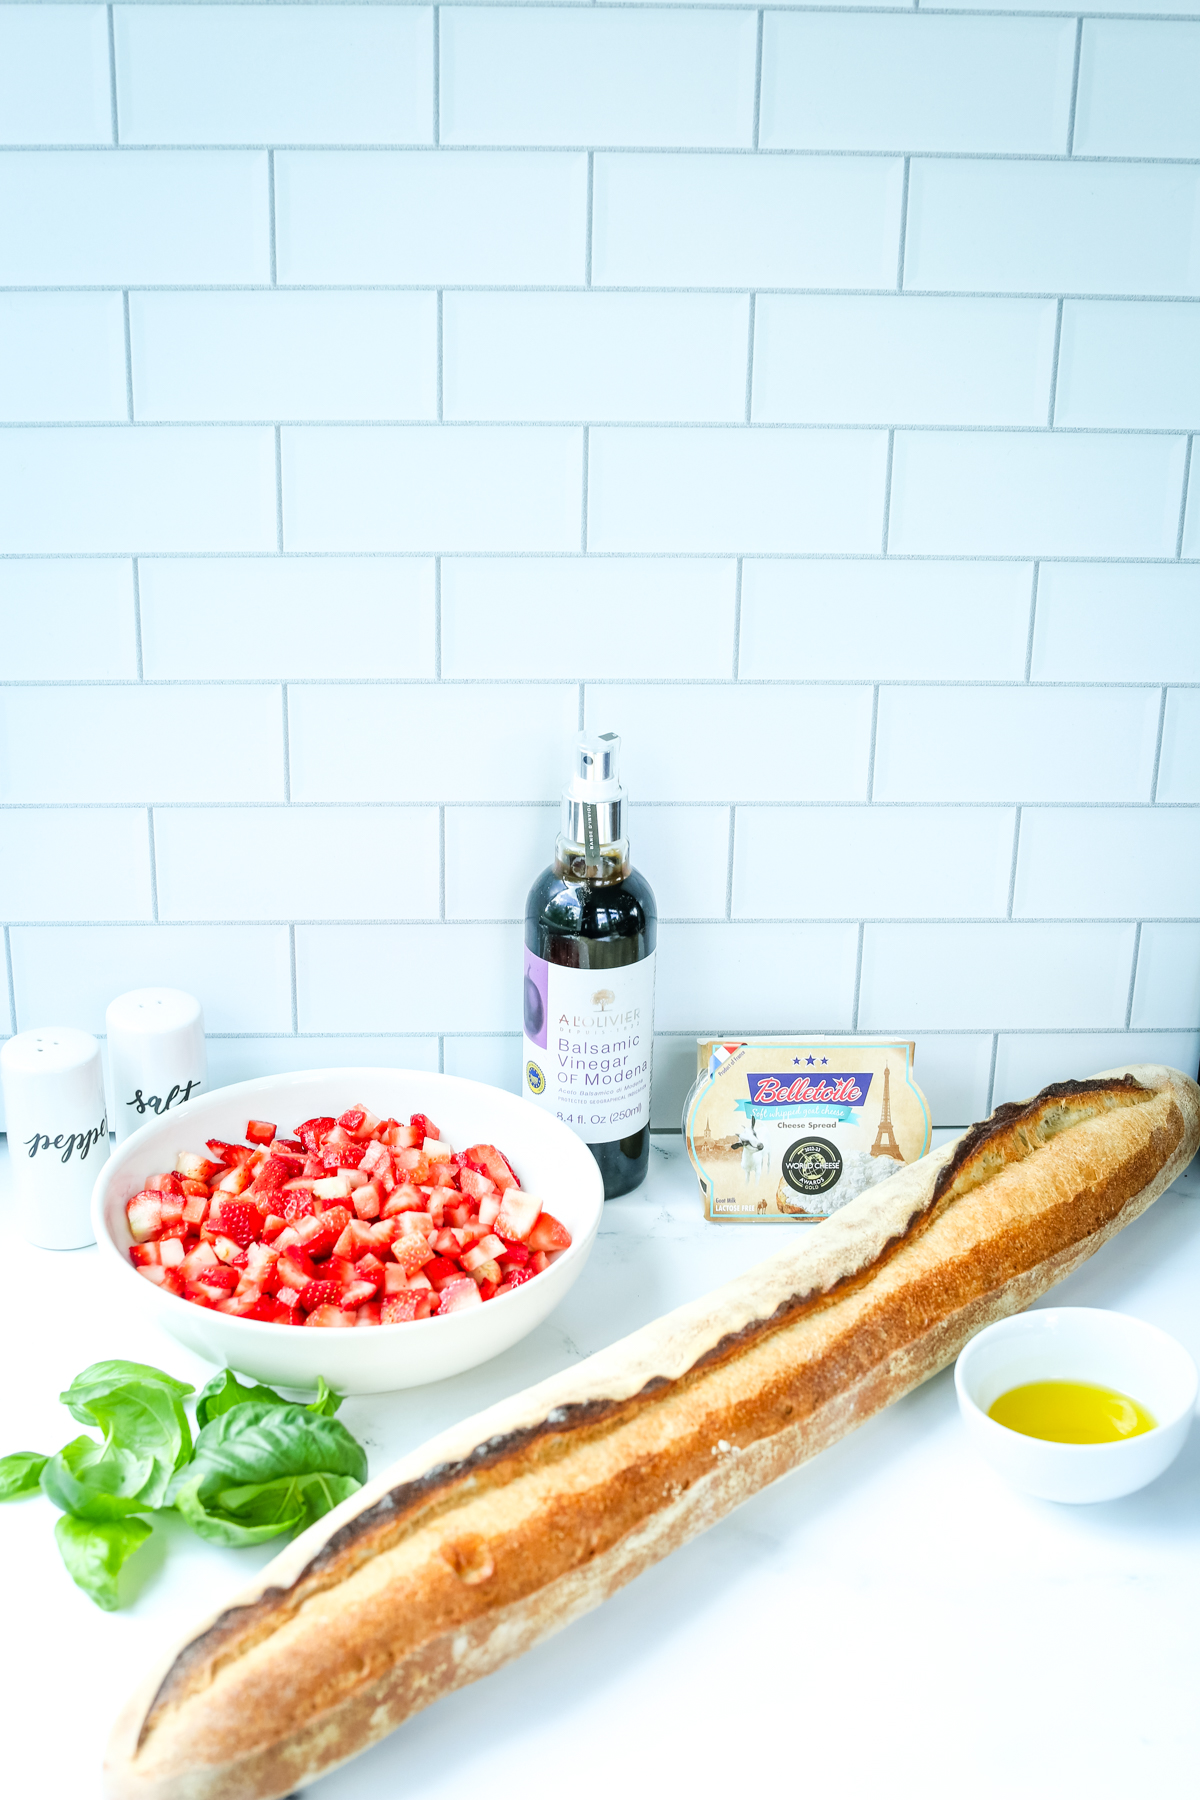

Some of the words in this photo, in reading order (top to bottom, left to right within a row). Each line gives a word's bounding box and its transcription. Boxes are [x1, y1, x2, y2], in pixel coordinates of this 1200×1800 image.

[558, 1036, 640, 1054] Balsamic
[558, 1054, 628, 1072] Vinegar
[558, 1072, 578, 1084] OF
[585, 1060, 648, 1086] Modena
[718, 1064, 732, 1076] Product
[734, 1050, 746, 1062] France
[126, 1080, 201, 1115] salt
[558, 1096, 587, 1104] PROTECTED
[590, 1096, 626, 1104] GEOGRAPHICAL
[754, 1077, 862, 1103] Belletoile
[556, 1112, 573, 1122] 8.4
[578, 1114, 586, 1124] fl.
[590, 1114, 606, 1124] Oz
[610, 1102, 642, 1124] (250ml)
[750, 1108, 768, 1119] Soft
[770, 1106, 802, 1120] whipped
[804, 1106, 820, 1117] goat
[821, 1106, 844, 1116] cheese
[23, 1109, 108, 1163] peppe
[808, 1122, 836, 1130] Spread
[800, 1177, 824, 1186] AWARDS
